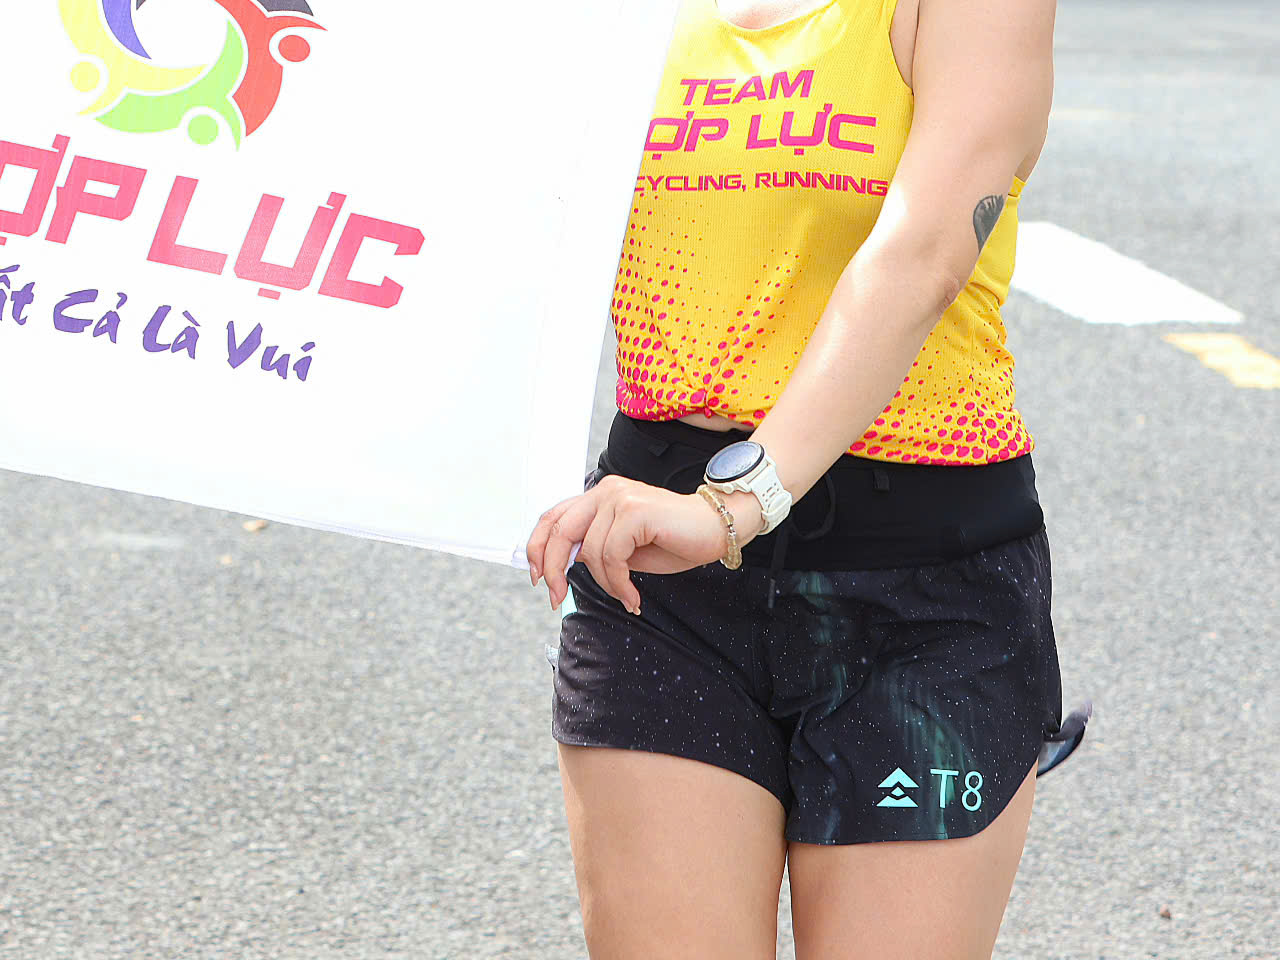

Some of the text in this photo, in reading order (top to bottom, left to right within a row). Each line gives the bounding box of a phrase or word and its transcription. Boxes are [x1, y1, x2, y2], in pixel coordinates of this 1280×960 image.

[680, 69, 816, 107] TEAM
[745, 103, 878, 157] LỰC
[754, 170, 889, 198] RUNNING
[146, 174, 426, 310] LỰC
[52, 288, 129, 344] Cả
[142, 304, 201, 360] Là
[226, 320, 317, 382] Vui
[930, 768, 984, 812] T8
